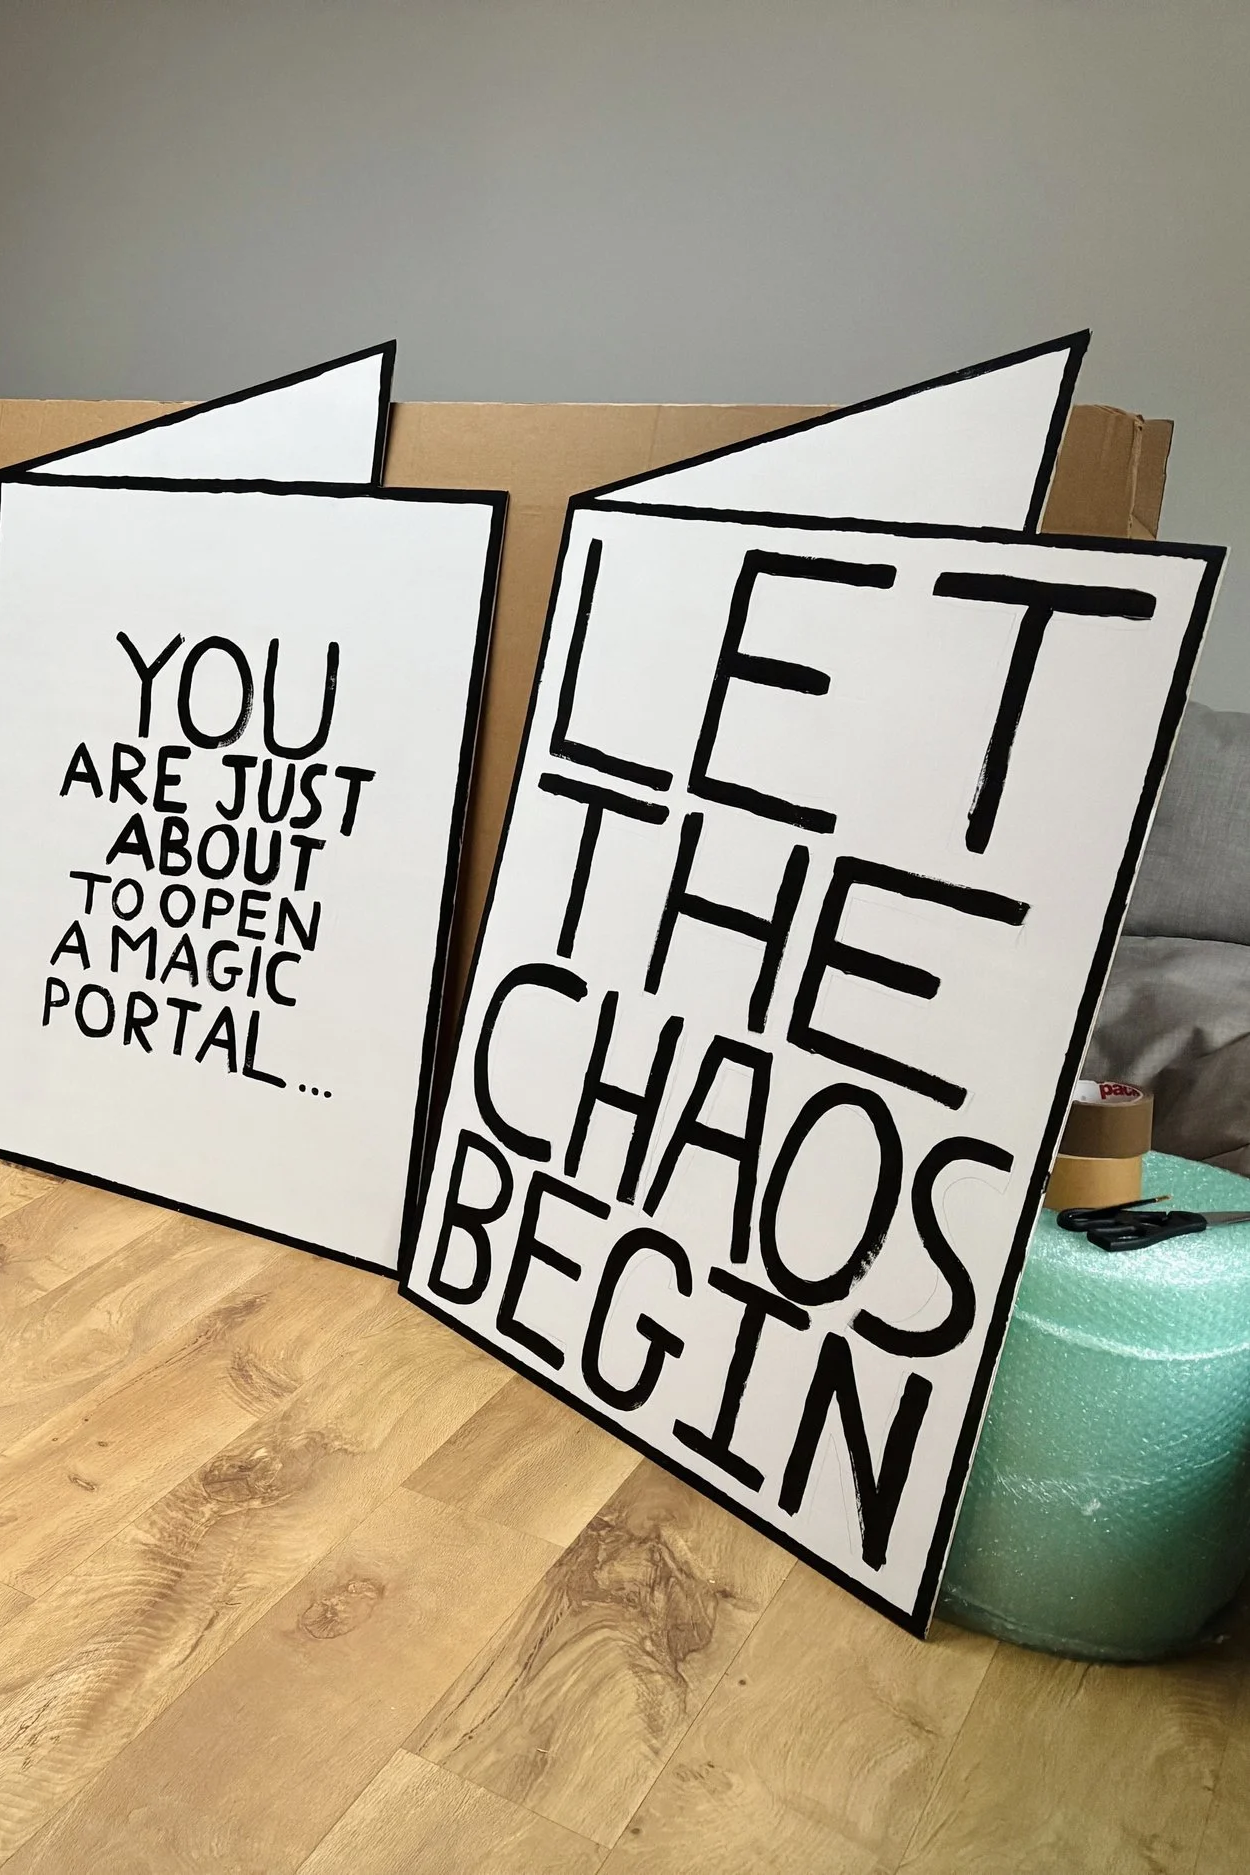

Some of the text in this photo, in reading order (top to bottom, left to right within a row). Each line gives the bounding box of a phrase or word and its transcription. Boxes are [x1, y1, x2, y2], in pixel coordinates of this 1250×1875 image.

[116, 631, 340, 760] YOU
[549, 538, 1158, 855] LET
[59, 742, 377, 837] ARE JUST
[106, 813, 327, 892] ABOUT
[50, 920, 302, 1008] A MAGIC
[69, 870, 322, 952] TO OPEN
[537, 771, 1032, 1112] THE
[473, 962, 1015, 1359] CHAOS
[427, 1127, 933, 1573] BEGIN
